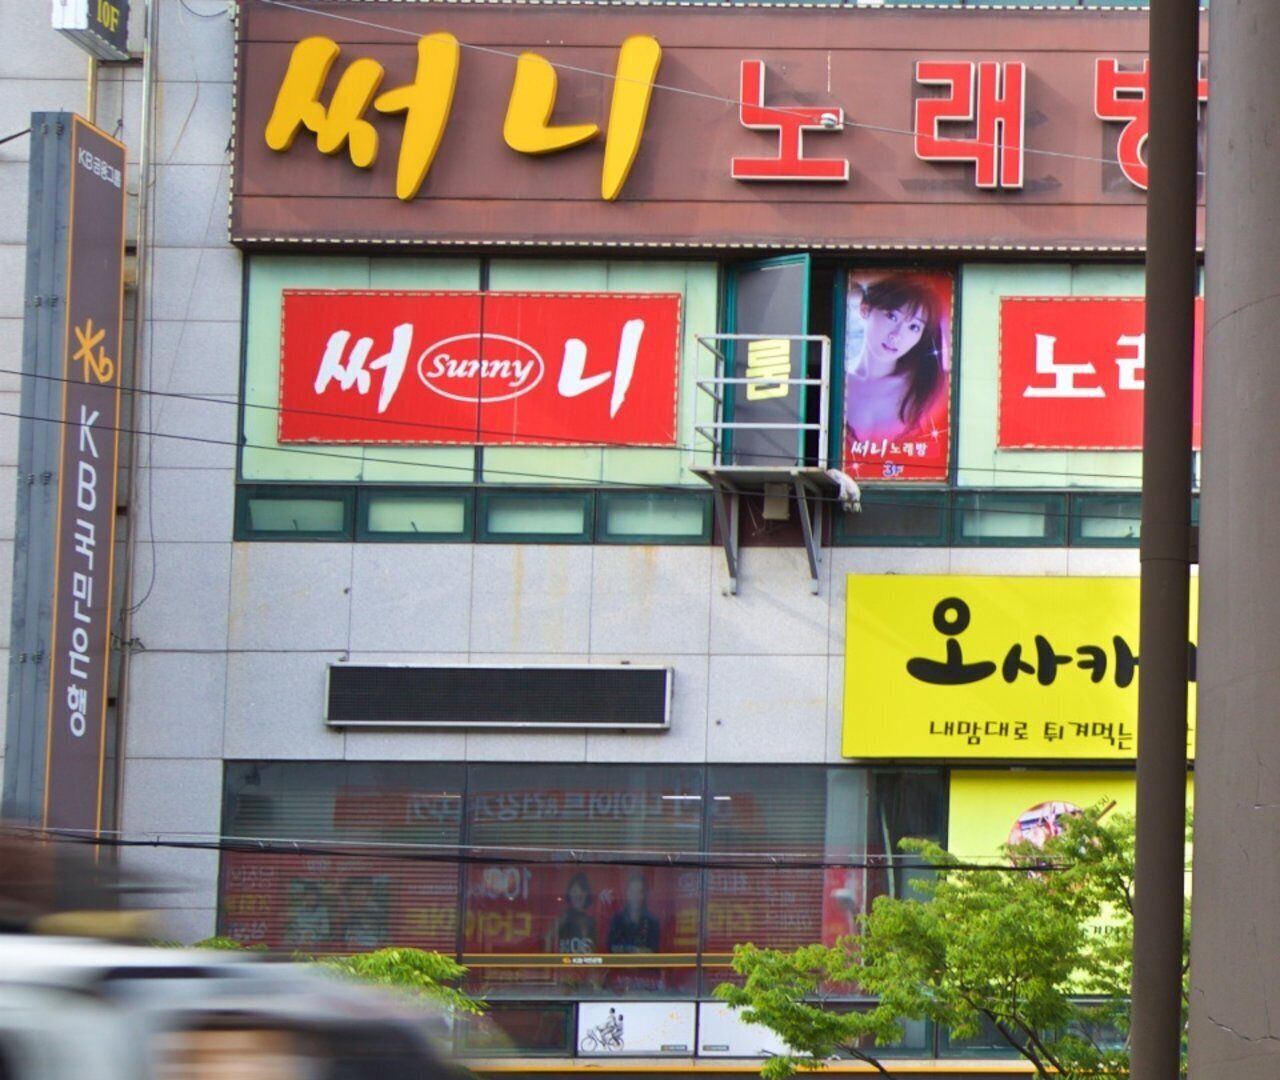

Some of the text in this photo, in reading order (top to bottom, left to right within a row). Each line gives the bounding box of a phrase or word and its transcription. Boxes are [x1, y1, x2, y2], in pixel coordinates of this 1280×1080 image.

[425, 350, 535, 388] Sunny
[851, 439, 928, 460] 써니 노래방
[882, 460, 904, 477] 3F
[70, 405, 99, 738] KB국민은행
[929, 720, 1133, 751] 내맘대로 튀겨먹는
